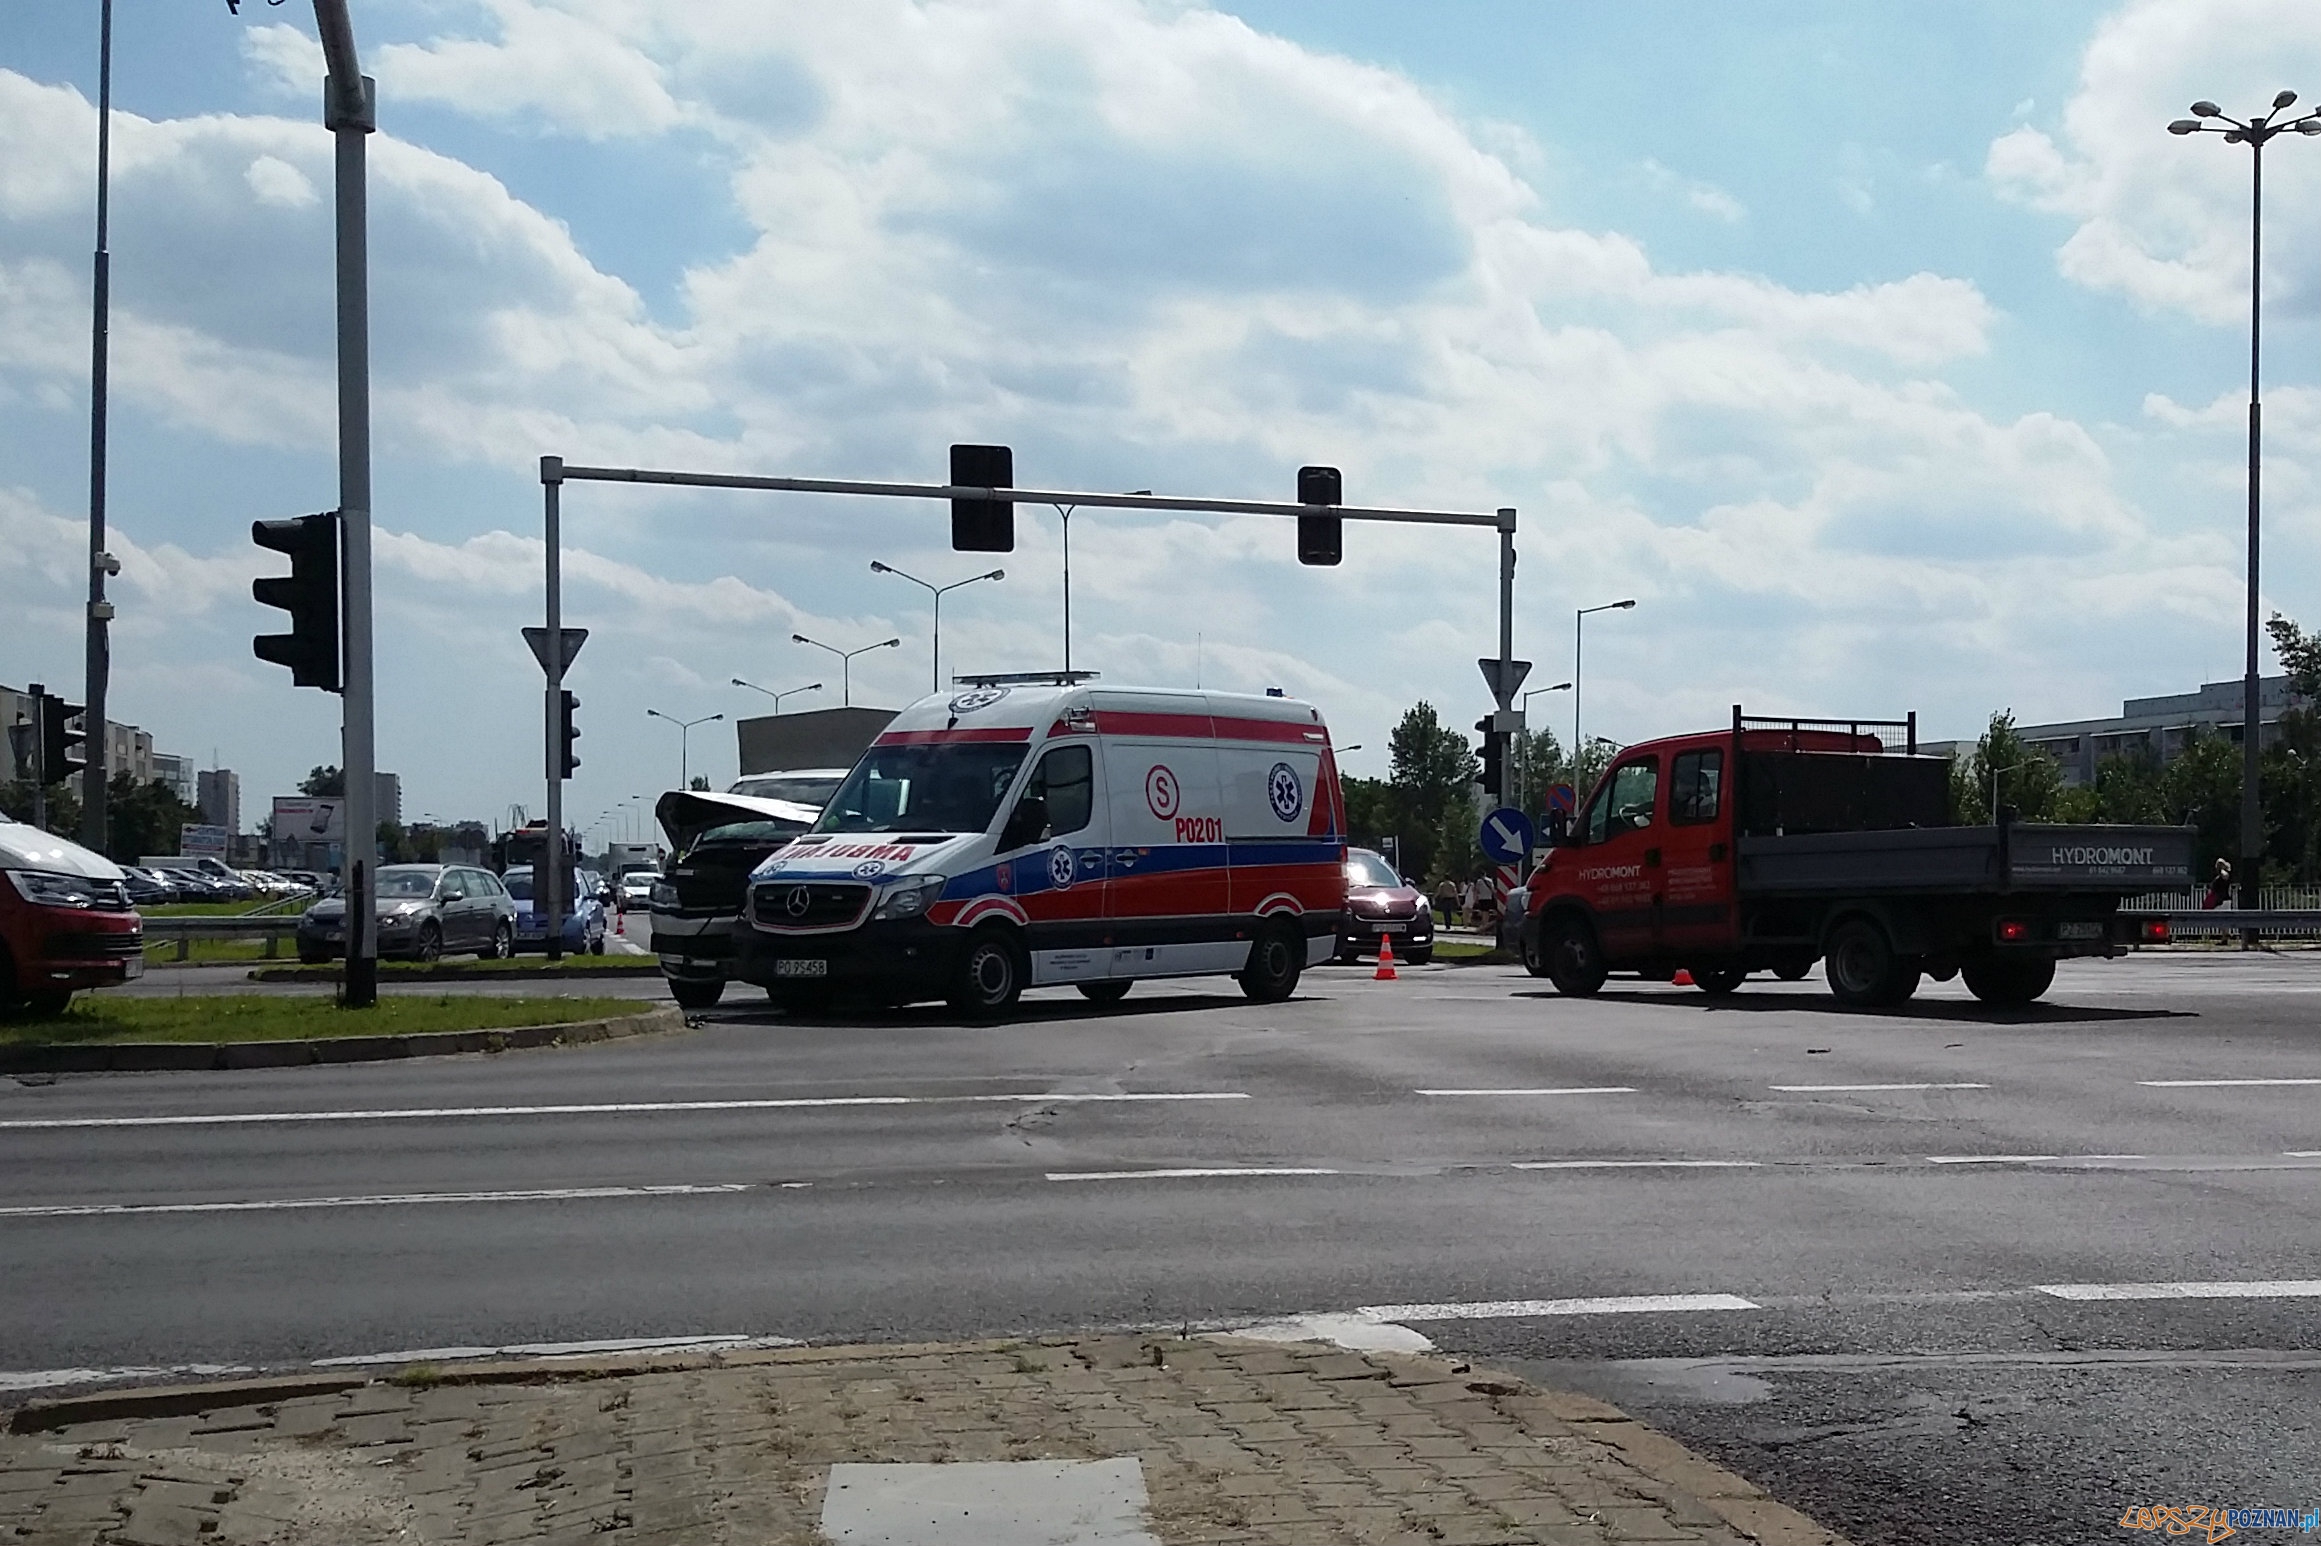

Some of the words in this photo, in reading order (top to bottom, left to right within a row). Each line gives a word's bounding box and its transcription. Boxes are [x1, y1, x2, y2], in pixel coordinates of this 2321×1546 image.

[1156, 776, 1170, 808] S
[2052, 847, 2152, 865] HYDROMONT
[1578, 865, 1641, 880] HYDROMONT
